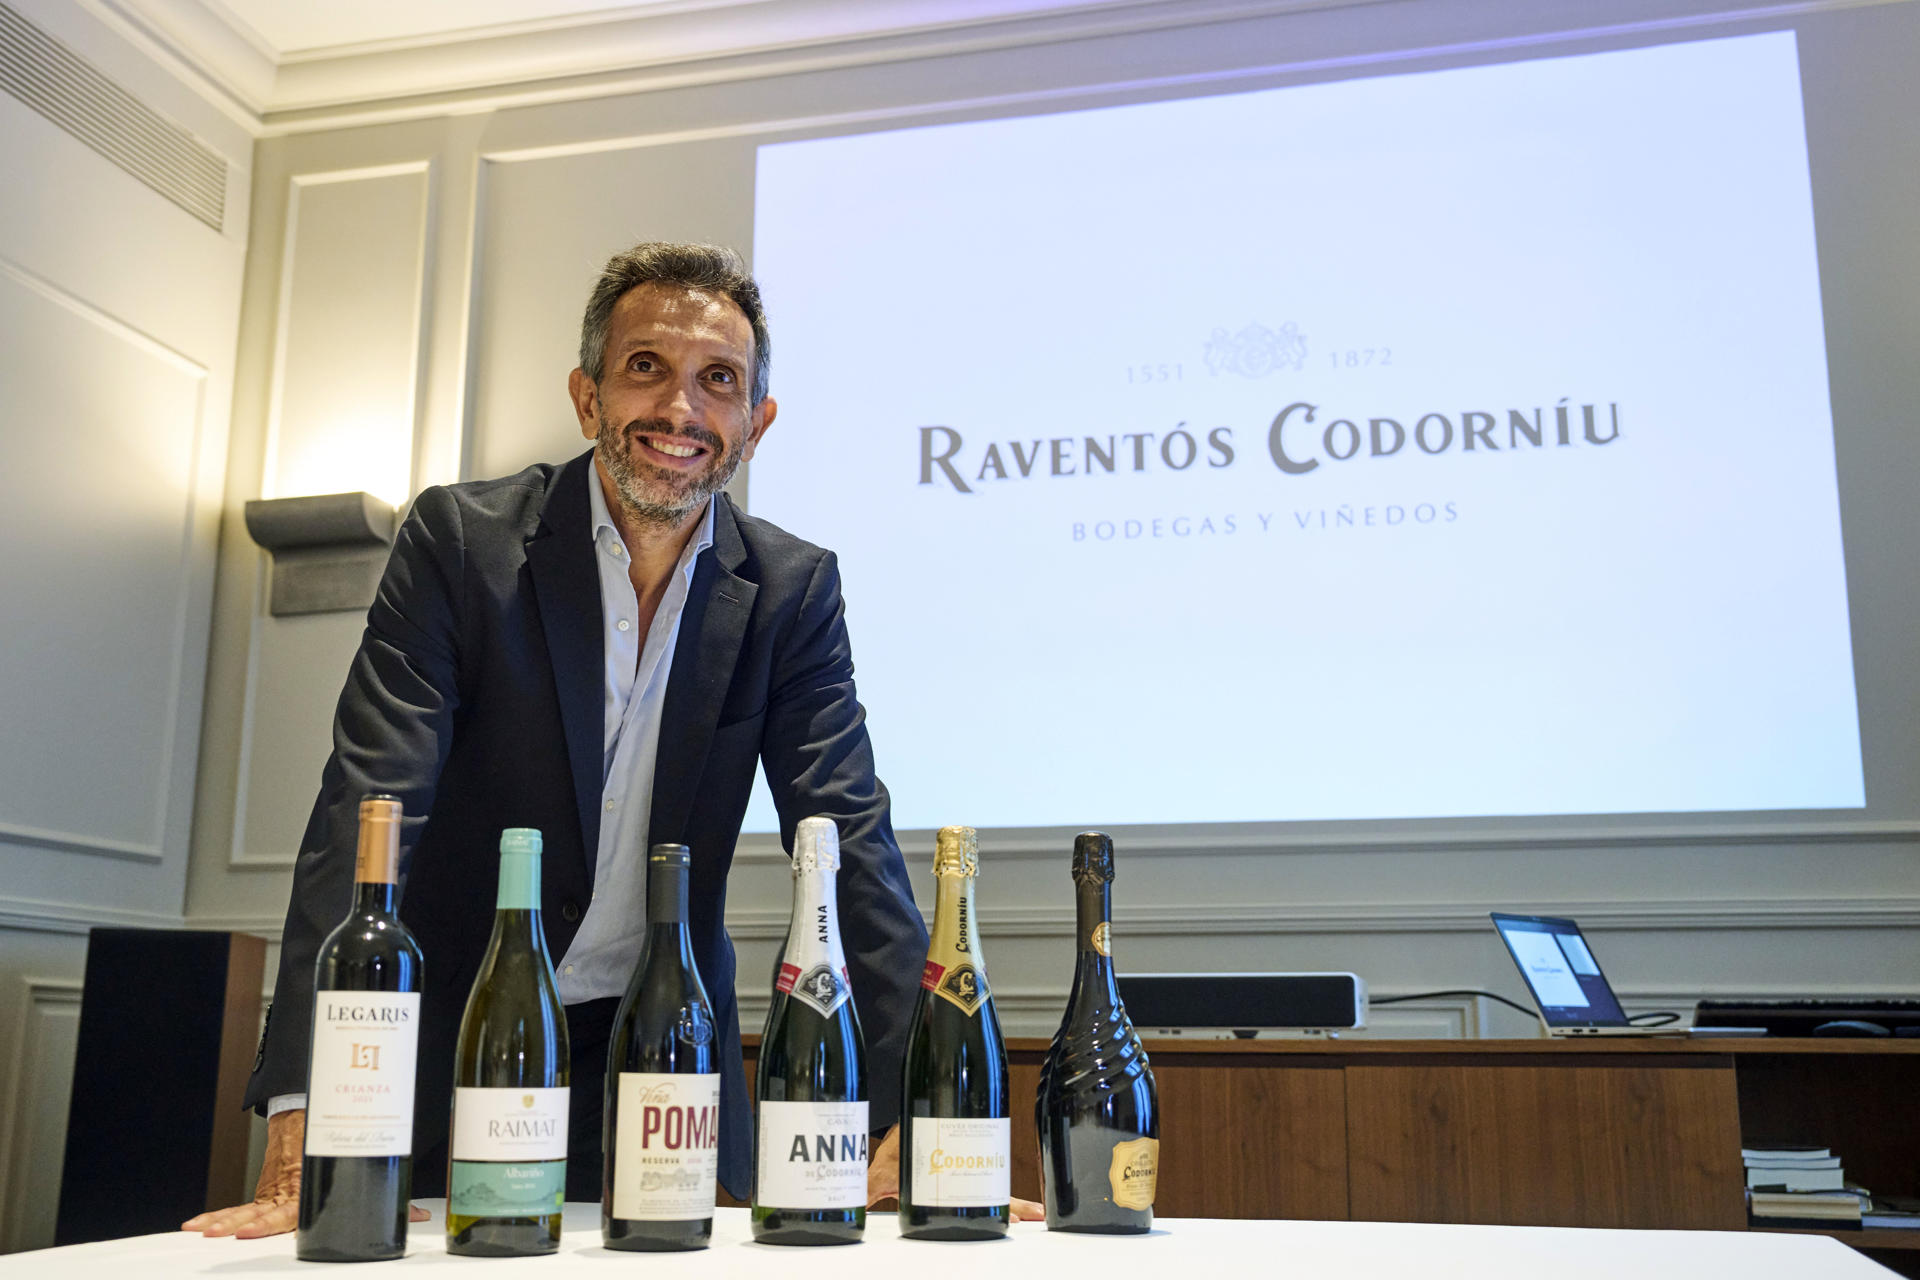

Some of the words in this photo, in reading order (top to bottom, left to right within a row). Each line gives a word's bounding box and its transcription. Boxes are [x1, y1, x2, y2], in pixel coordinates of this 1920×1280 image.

[1330, 347, 1393, 369] 1872
[1125, 364, 1185, 385] 1551
[918, 422, 1235, 493] RAVENTÓS
[1268, 398, 1622, 475] CODORNÍU
[1072, 514, 1237, 542] BODEGAS
[1257, 513, 1272, 532] Y
[1294, 502, 1459, 530] VIÑEDOS
[818, 905, 828, 943] ANNA
[328, 1004, 409, 1024] LEGARIS
[335, 1084, 391, 1094] CRIANZA
[488, 1119, 557, 1138] RAIMAT
[788, 1133, 867, 1162] ANNA
